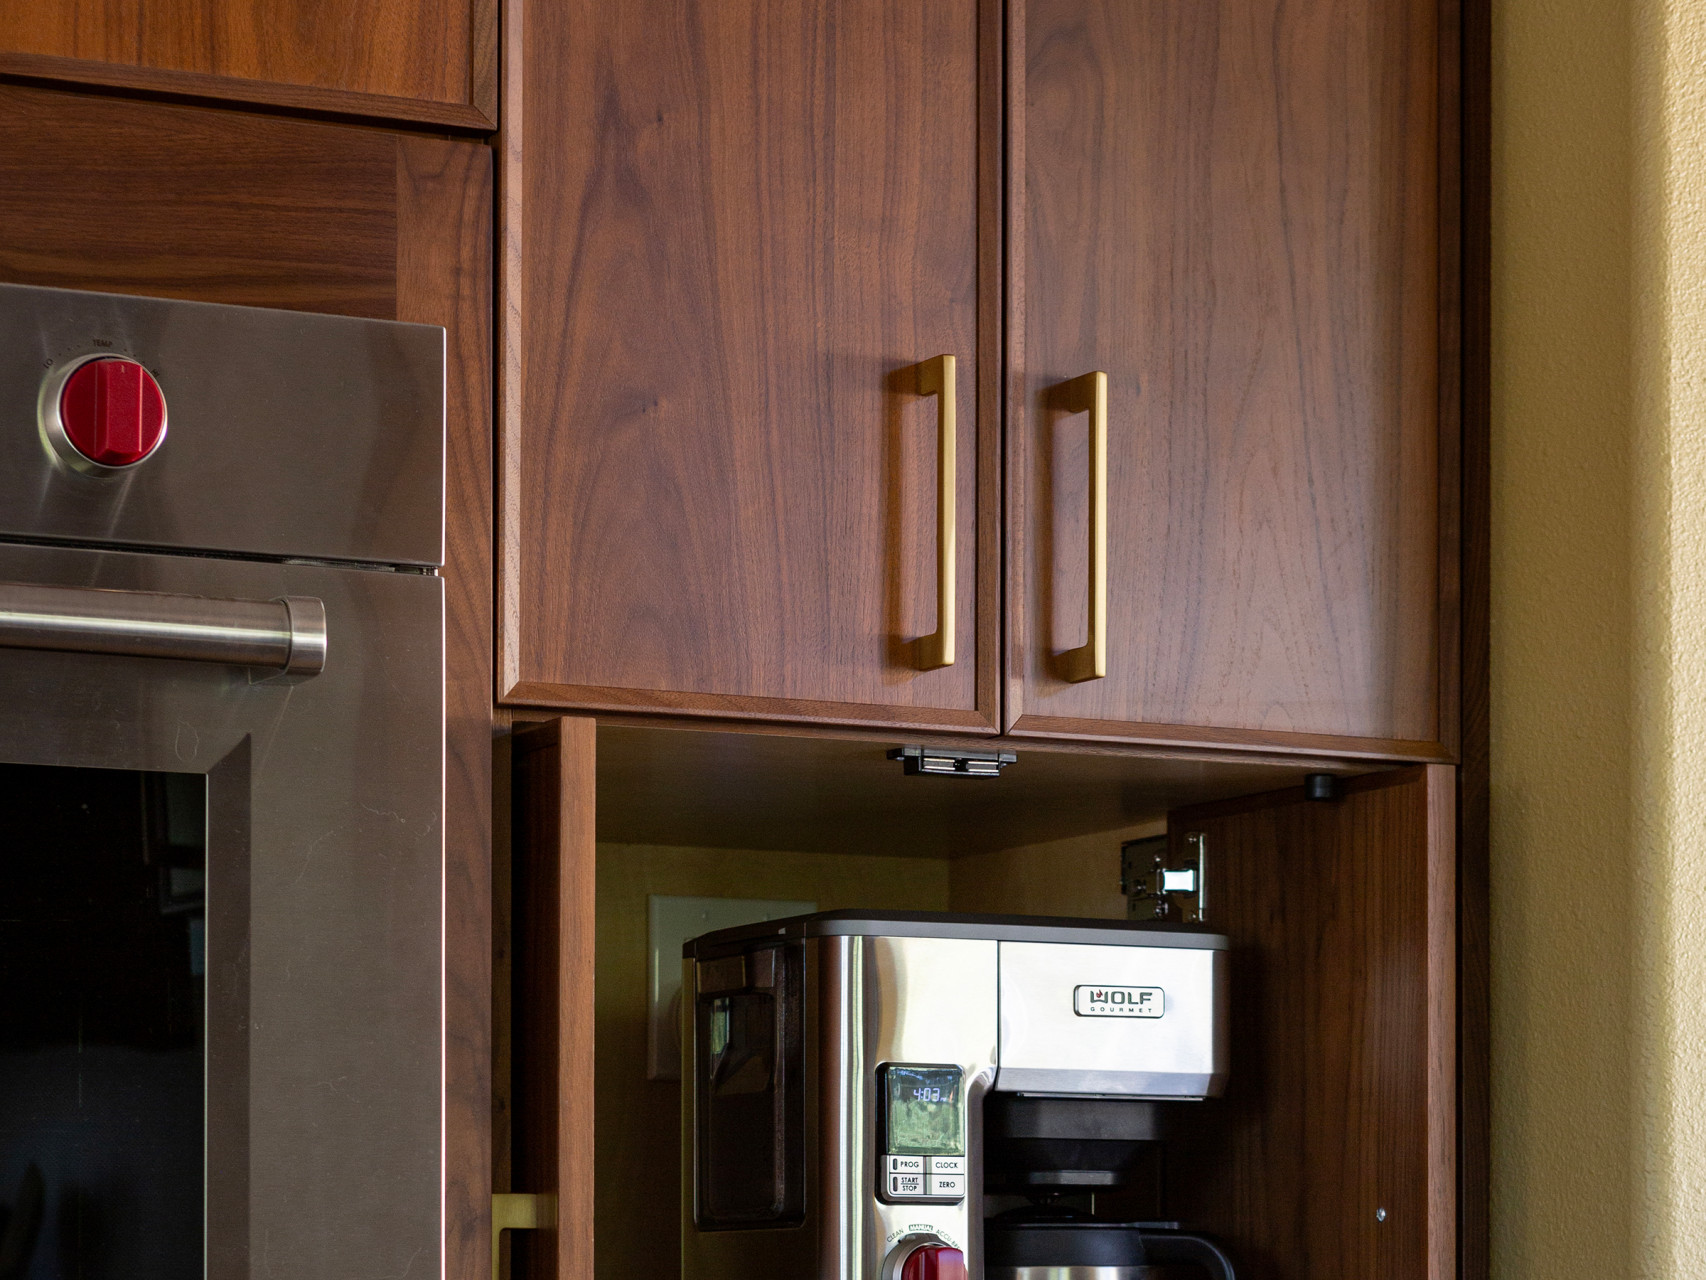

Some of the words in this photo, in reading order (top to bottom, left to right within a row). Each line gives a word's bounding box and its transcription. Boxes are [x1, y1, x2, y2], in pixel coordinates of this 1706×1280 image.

[93, 339, 113, 347] TEMP
[1090, 990, 1153, 1005] WOLF
[887, 1229, 904, 1243] CLEAN
